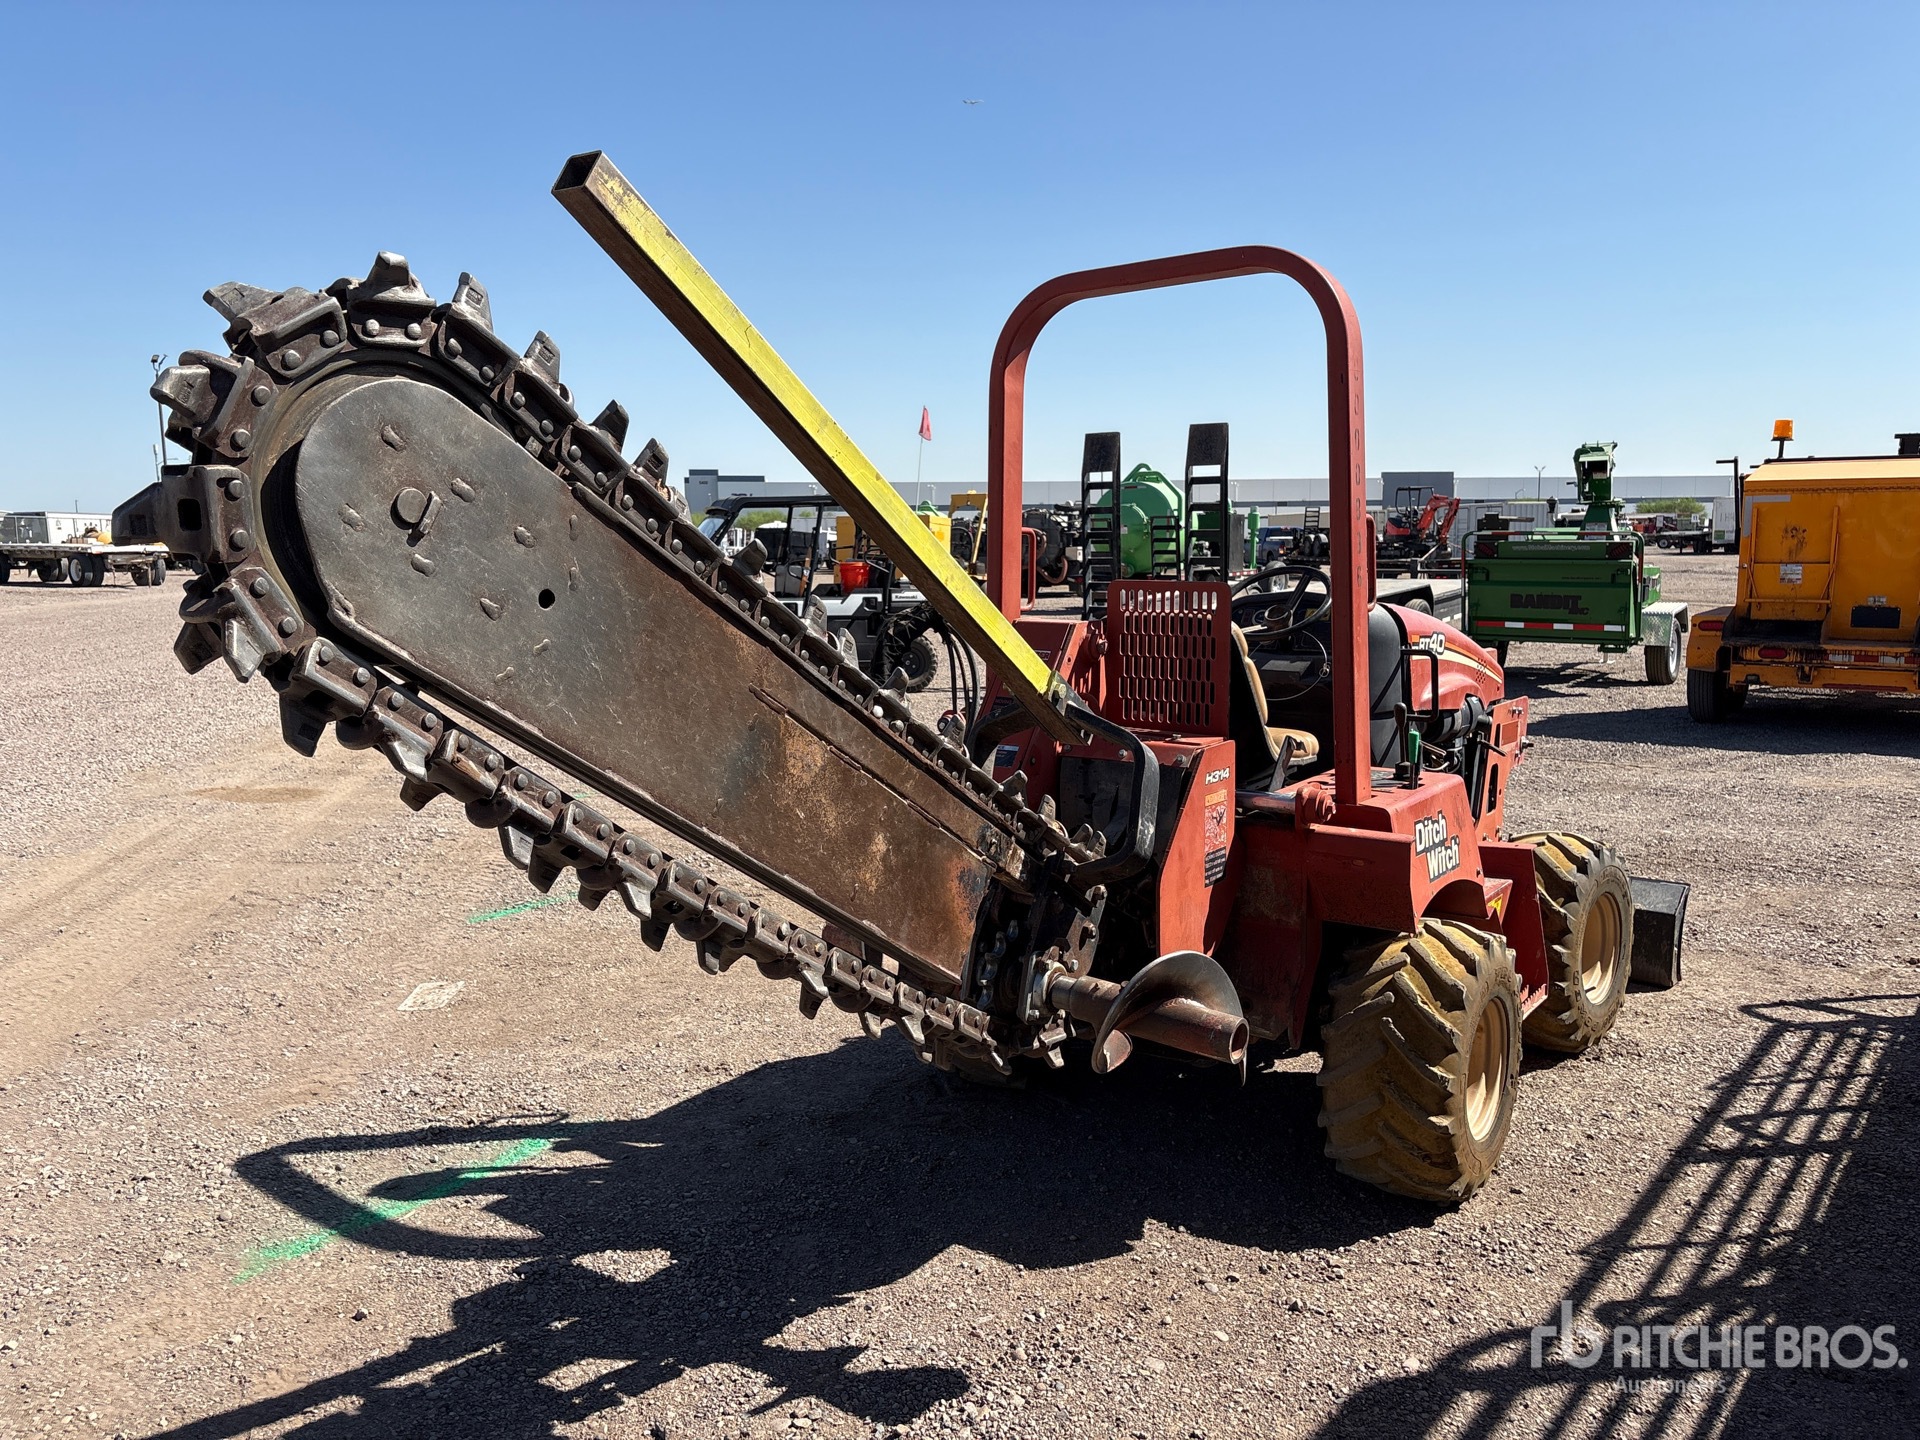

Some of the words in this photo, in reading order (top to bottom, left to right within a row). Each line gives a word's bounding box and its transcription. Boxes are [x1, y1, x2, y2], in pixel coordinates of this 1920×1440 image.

[1510, 593, 1582, 609] BANDIT
[1205, 767, 1230, 785] H314
[1415, 812, 1447, 853] Ditch
[1426, 839, 1459, 880] Witch
